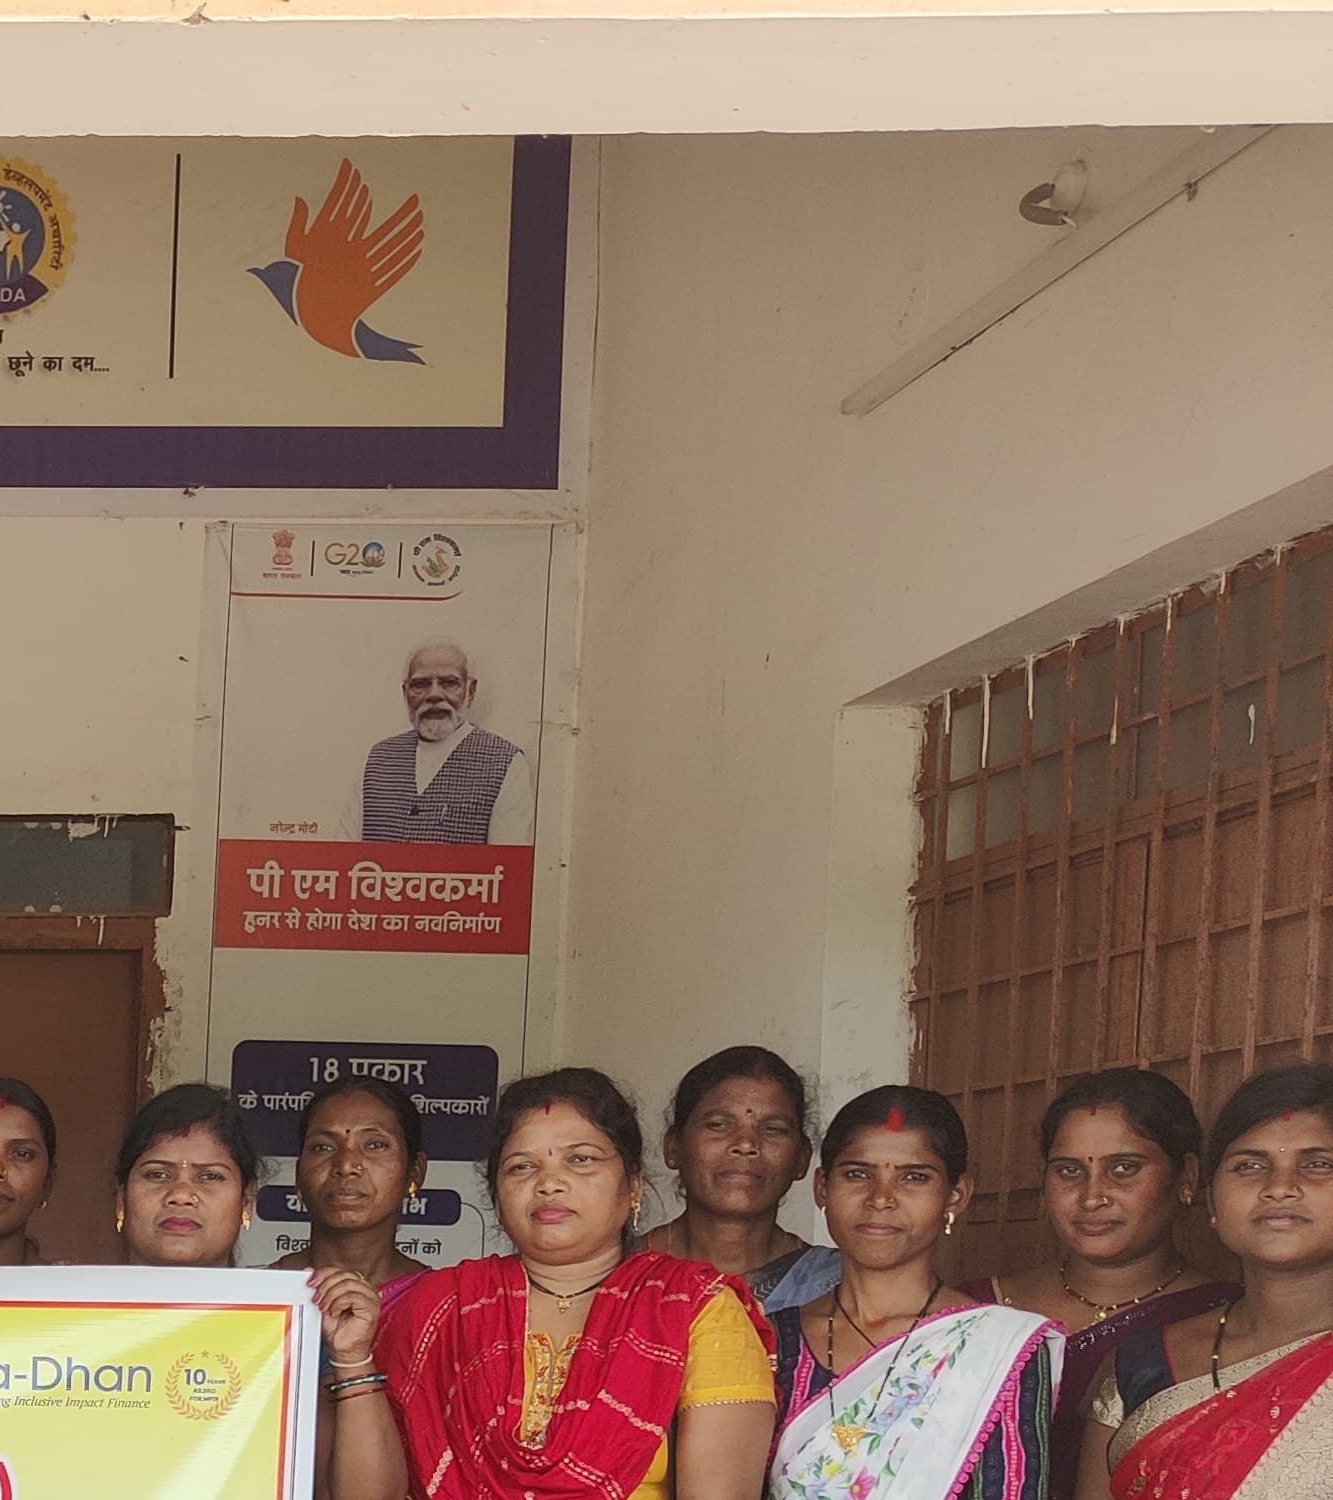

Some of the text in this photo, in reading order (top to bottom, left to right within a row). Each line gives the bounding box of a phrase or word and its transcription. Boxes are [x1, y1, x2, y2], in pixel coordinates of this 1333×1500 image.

[8, 350, 34, 377] छूने
[42, 356, 64, 372] का
[247, 861, 505, 903] पी एम विश्वकर्मा
[244, 907, 501, 934] हुनर से होगा देश का नवनिर्माण
[309, 1056, 339, 1083] 18
[238, 1090, 258, 1110] के
[422, 1239, 442, 1255] को
[184, 1368, 207, 1386] 10
[13, 1396, 63, 1408] Inclusive
[65, 1397, 104, 1411] Impact
[107, 1398, 151, 1409] Finance
